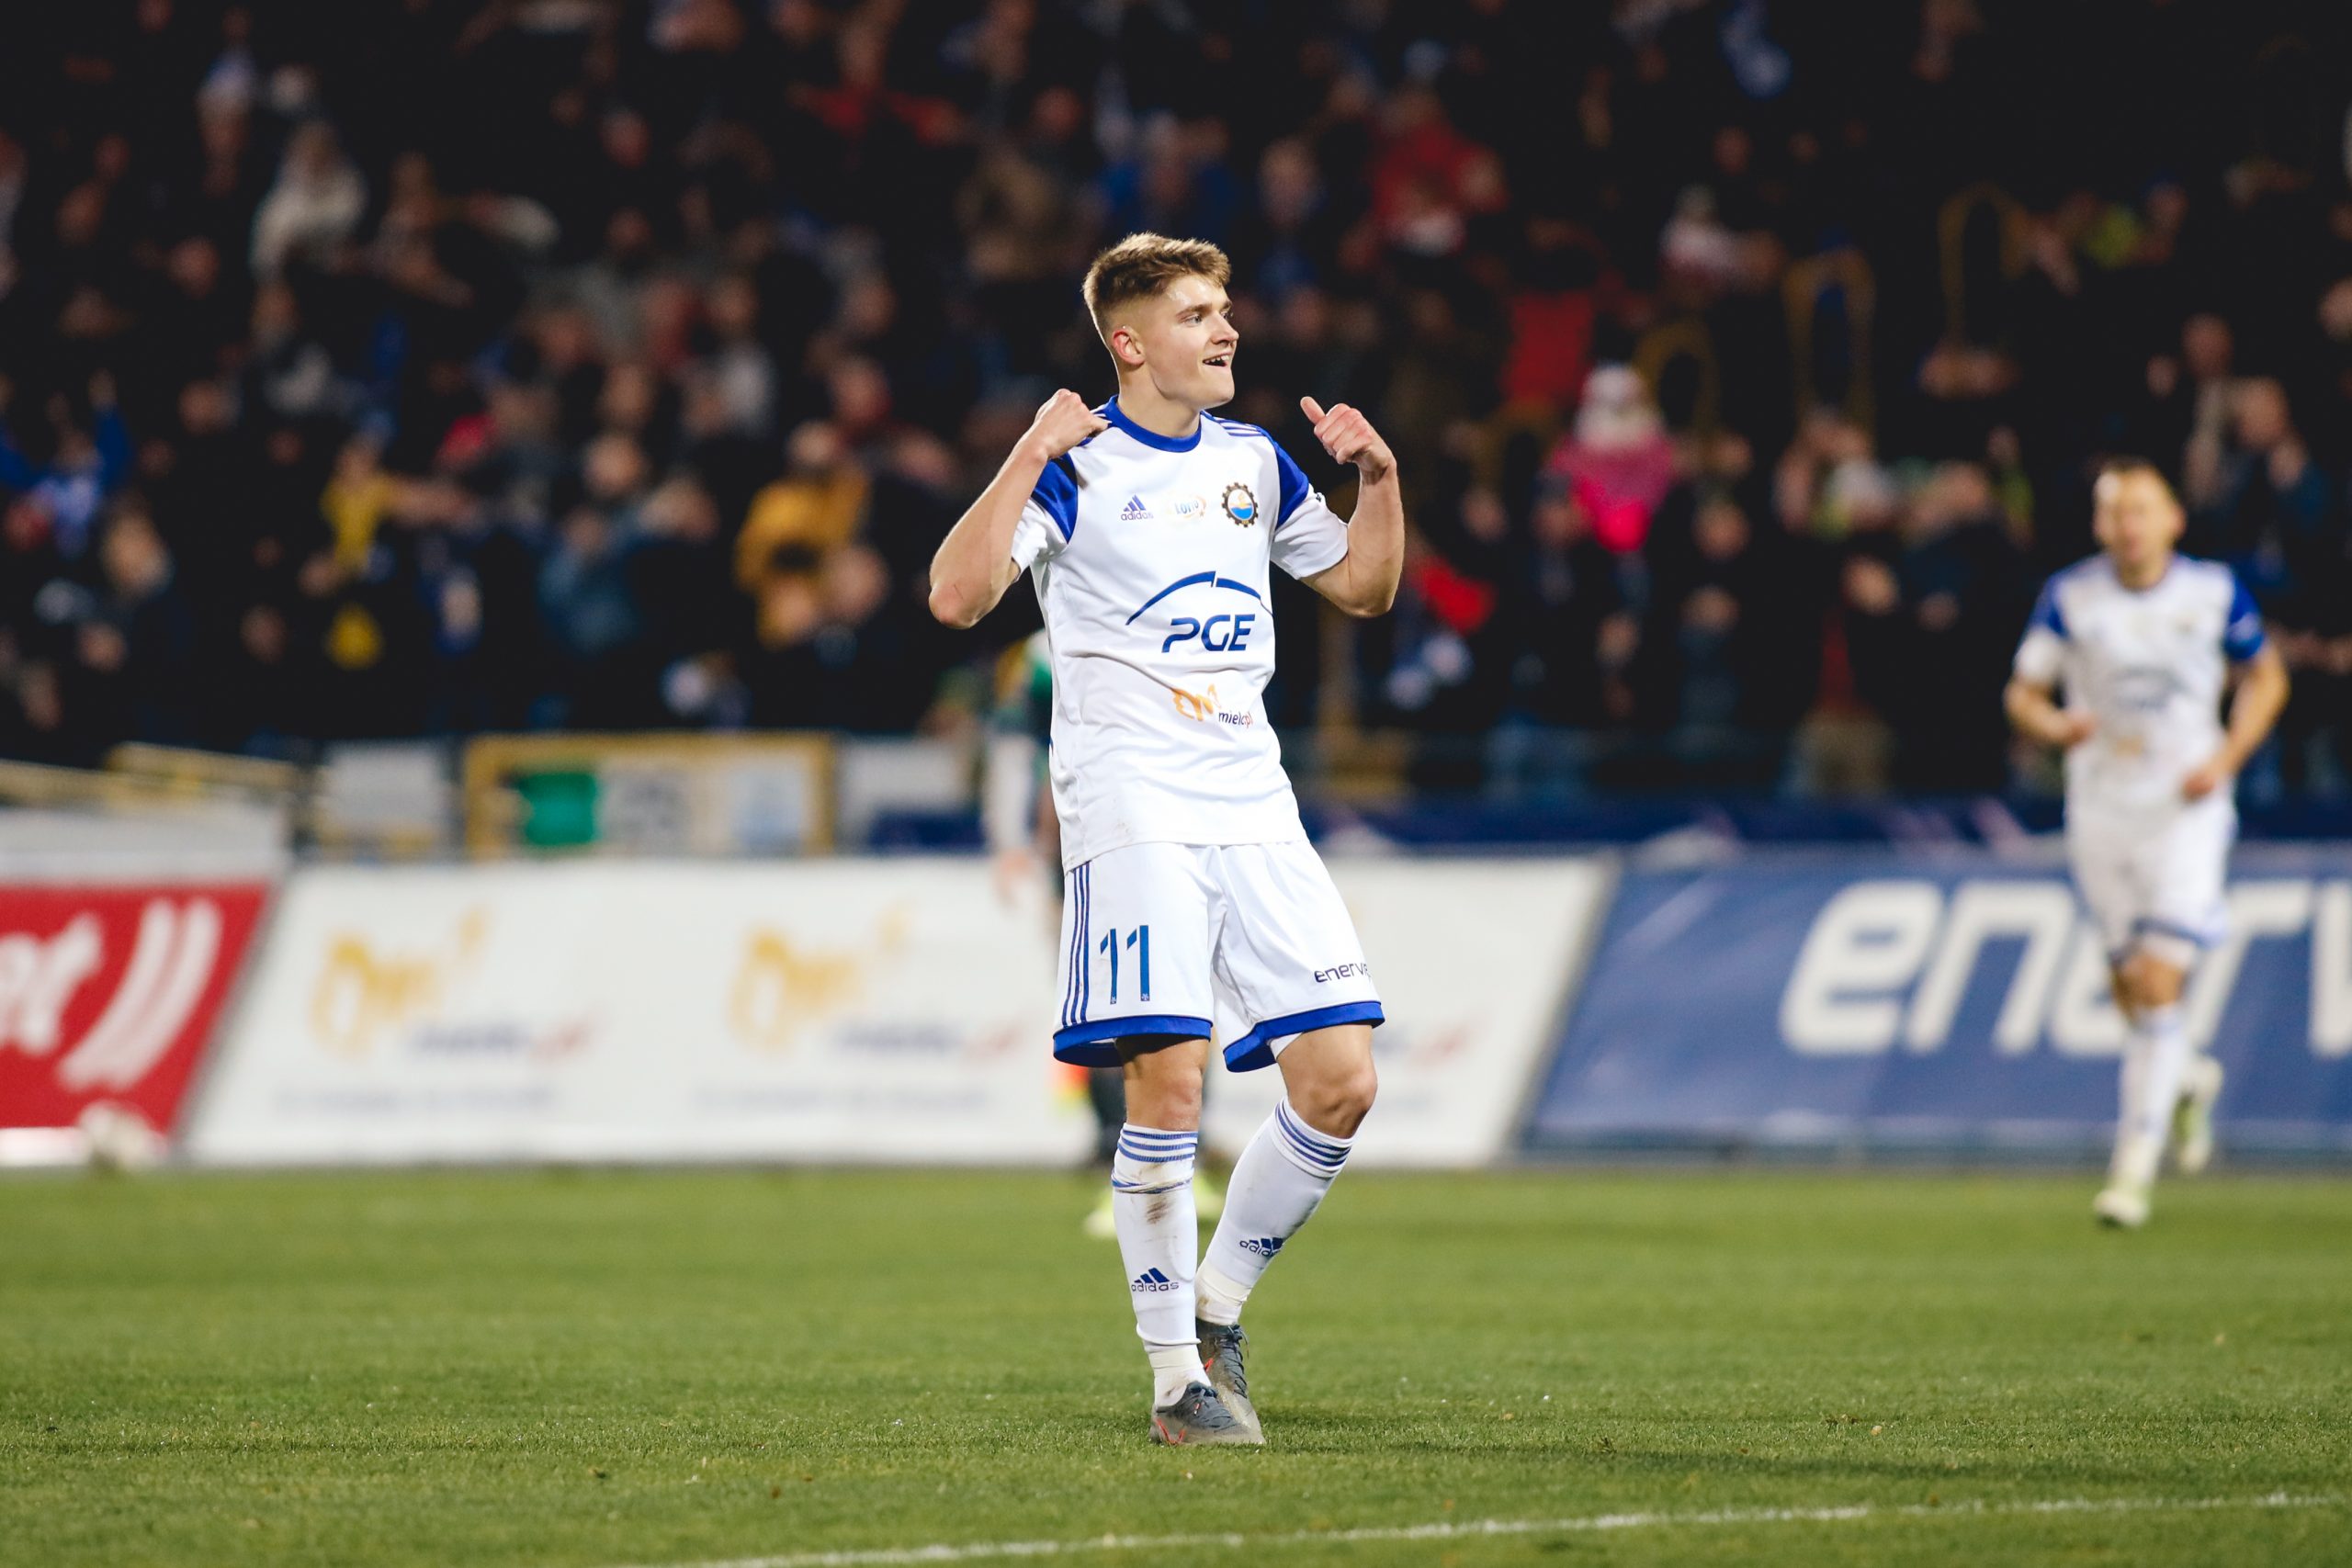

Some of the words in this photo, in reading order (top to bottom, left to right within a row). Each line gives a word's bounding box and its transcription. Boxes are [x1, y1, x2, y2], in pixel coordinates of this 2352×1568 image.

[1161, 614, 1256, 653] PGE
[1100, 925, 1150, 1005] 11
[1131, 1281, 1180, 1292] adidas
